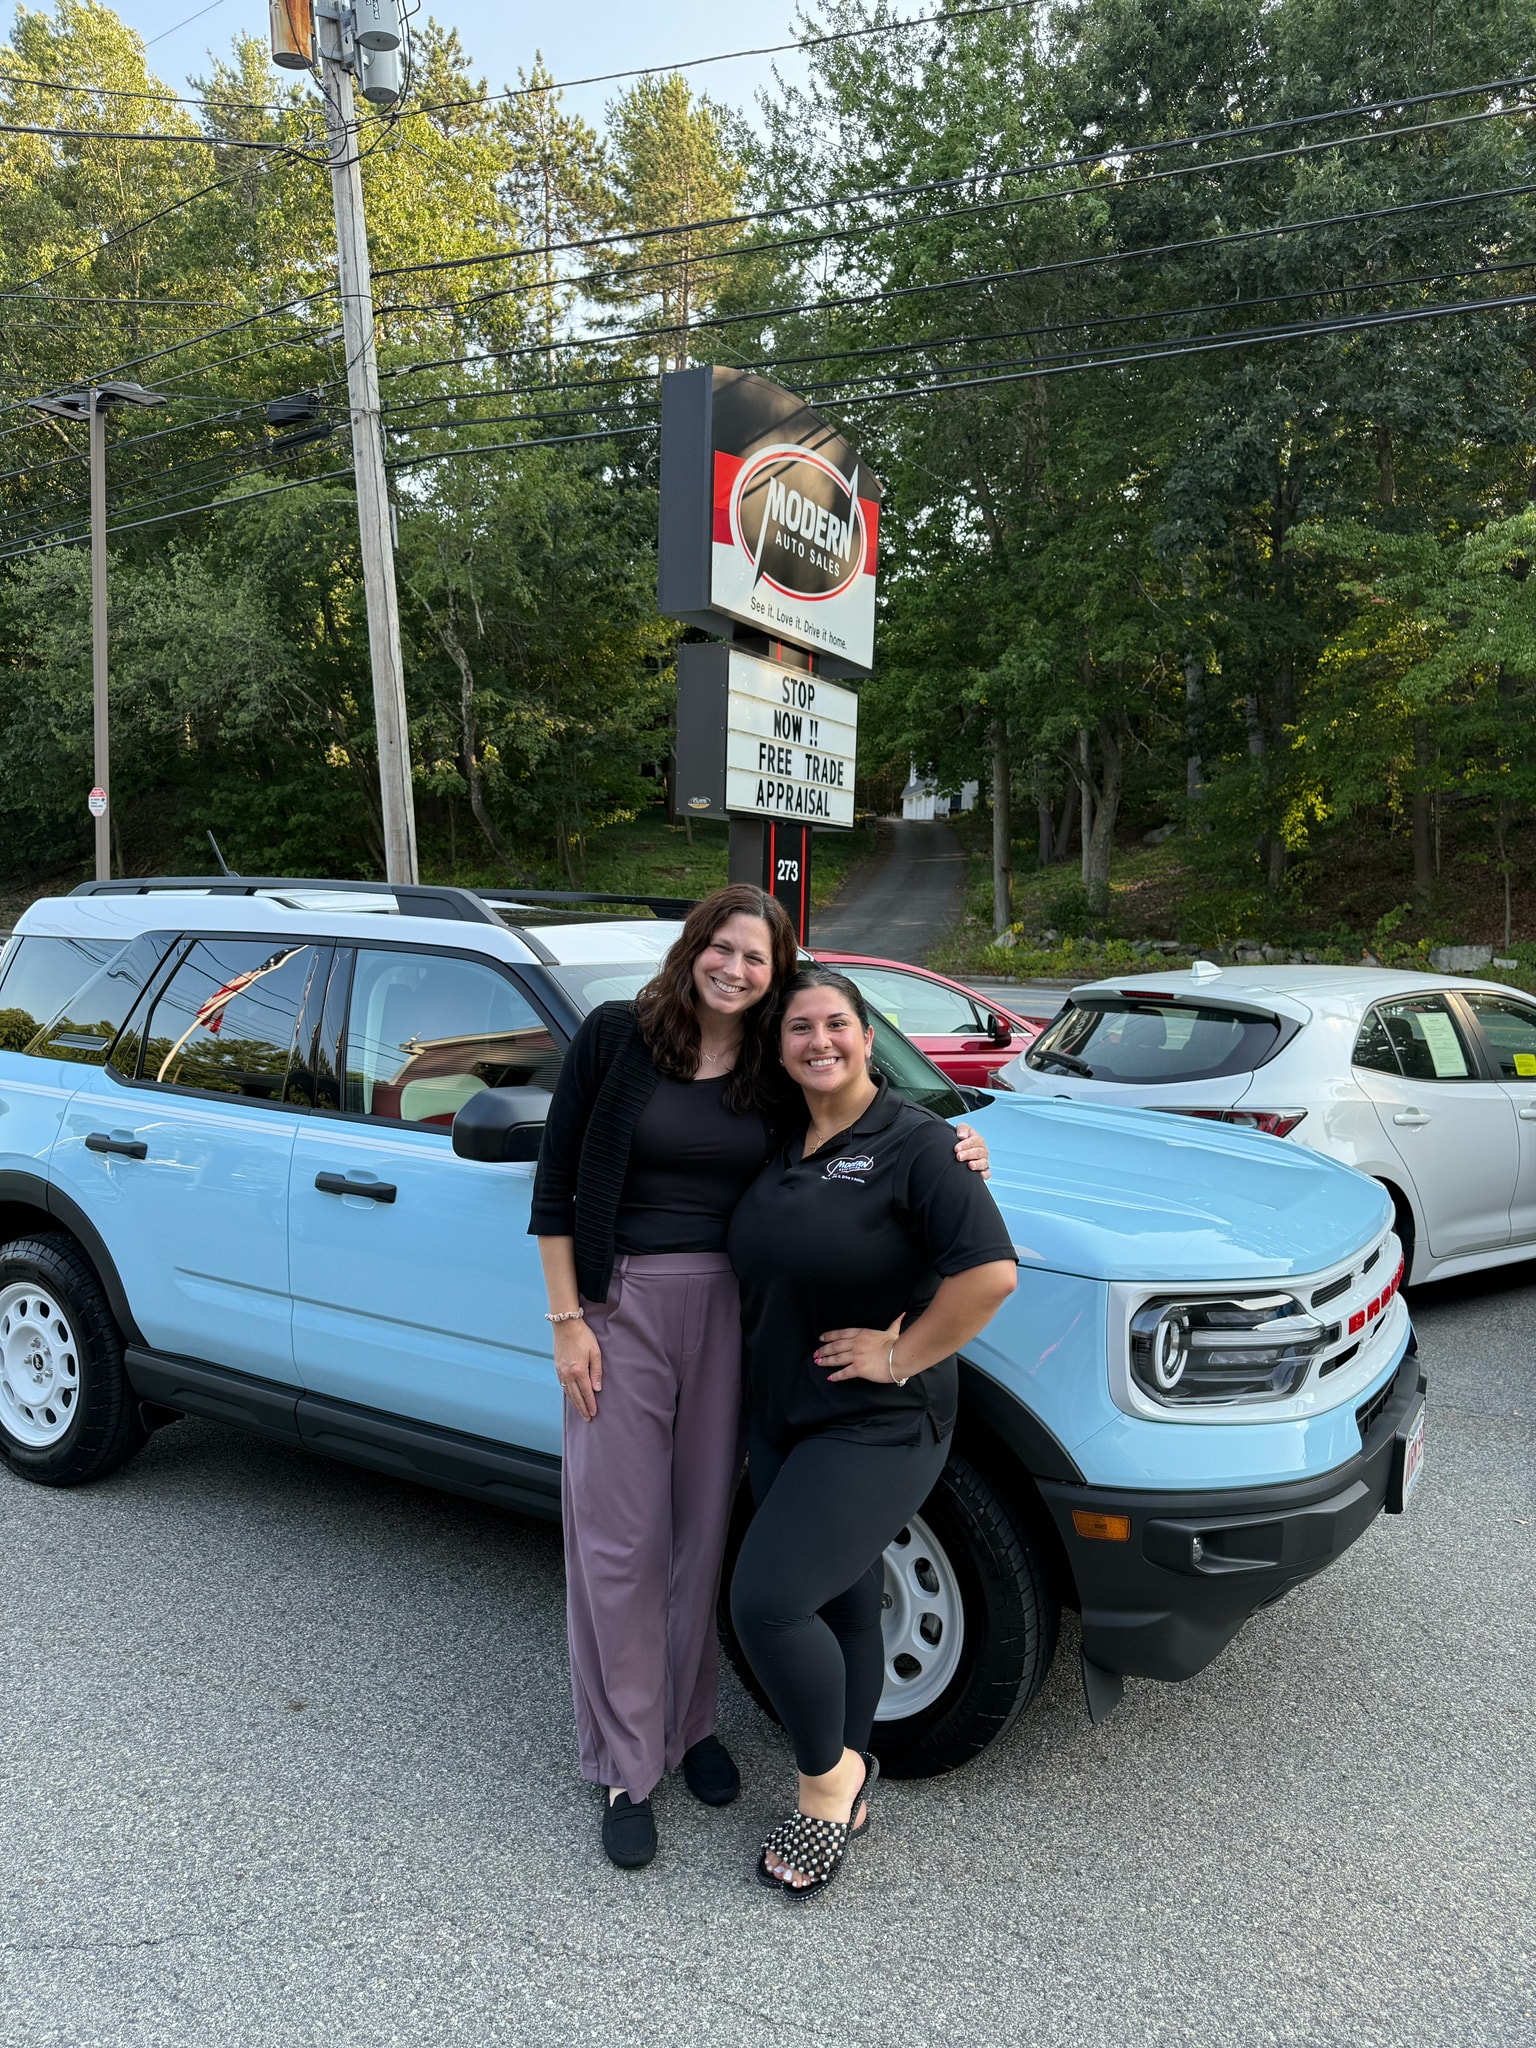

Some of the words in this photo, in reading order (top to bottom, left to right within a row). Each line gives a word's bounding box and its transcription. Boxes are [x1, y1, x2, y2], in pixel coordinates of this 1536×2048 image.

[753, 463, 858, 590] MODERN
[775, 530, 805, 558] AUTO
[809, 548, 840, 578] SALES
[750, 596, 765, 614] See
[776, 608, 793, 626] Love
[803, 620, 820, 638] Drive
[821, 628, 827, 642] it
[829, 631, 847, 650] home.
[782, 676, 815, 711] STOP
[773, 709, 802, 743] NOW
[810, 720, 818, 747] !!
[759, 743, 792, 776] FREE
[805, 754, 843, 787] TRADE
[756, 779, 830, 817] APPRAISAL
[777, 860, 798, 882] 273
